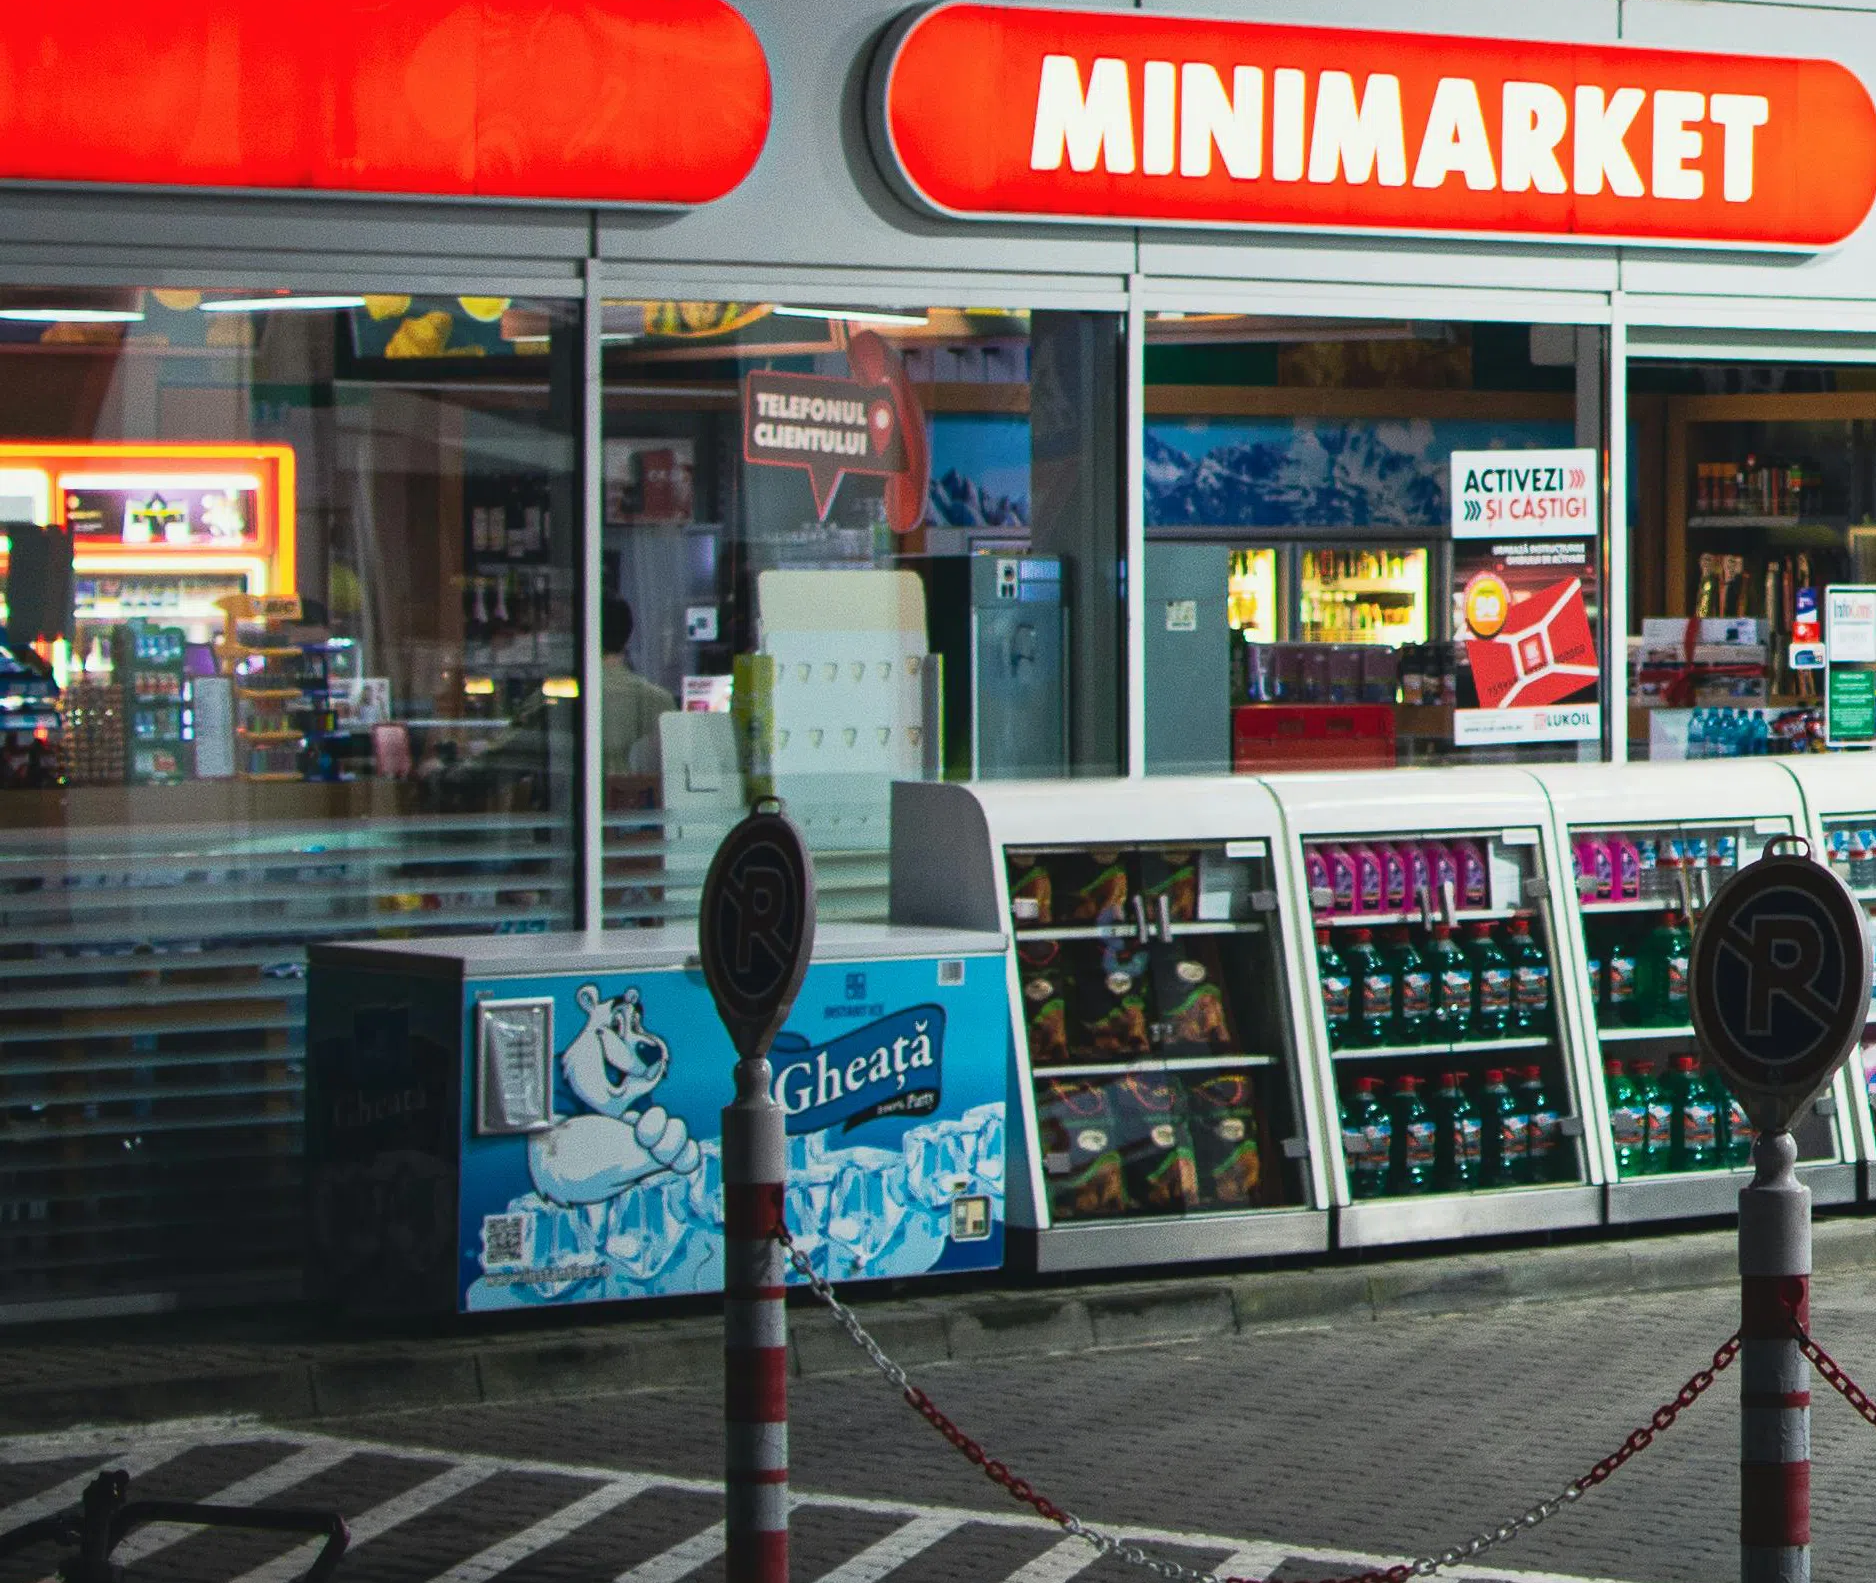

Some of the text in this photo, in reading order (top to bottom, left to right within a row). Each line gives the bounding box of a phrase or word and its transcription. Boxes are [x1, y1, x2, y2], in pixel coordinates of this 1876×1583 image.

[1030, 54, 1769, 203] MINIMARKET
[756, 392, 867, 426] TELEFONUL
[753, 422, 867, 456] CLIENTULUI
[1464, 468, 1564, 494] ACTIVEZI
[1546, 712, 1591, 729] LUKOIL
[774, 1018, 934, 1115] Gheață
